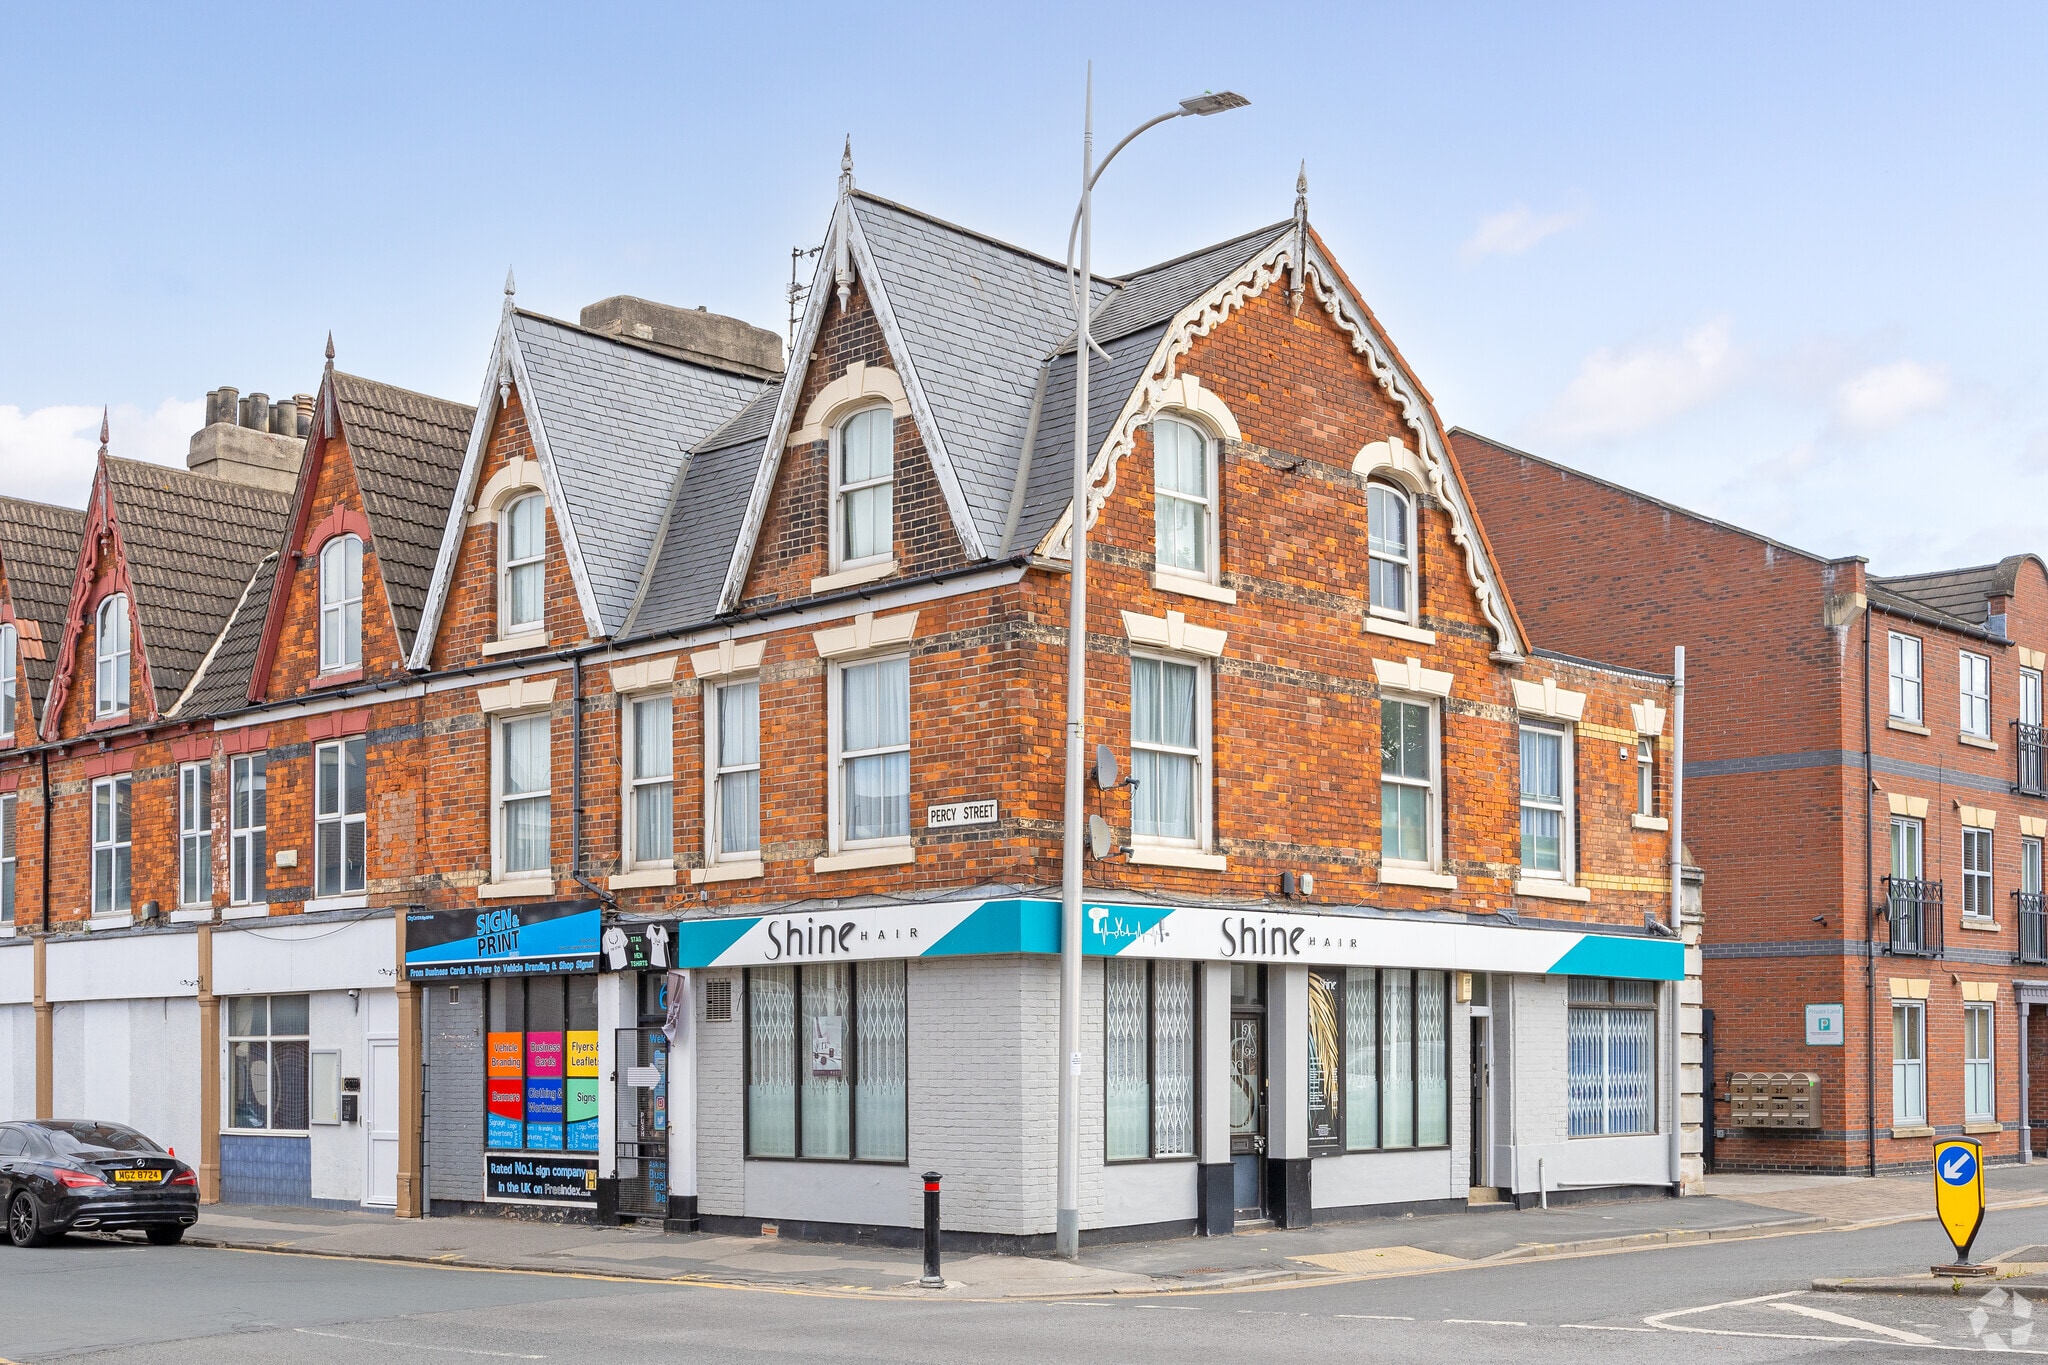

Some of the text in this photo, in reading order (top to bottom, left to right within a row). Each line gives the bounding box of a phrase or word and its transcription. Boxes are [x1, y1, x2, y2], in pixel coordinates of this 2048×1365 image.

[930, 804, 994, 823] PERCY STREET
[764, 917, 918, 960] Shine HAIR
[1220, 916, 1357, 957] Shine HAIR
[478, 930, 519, 956] PRINT
[410, 960, 594, 977] From Business Cards & Flyers to Vehicle Branding & Shop Signs!
[494, 1043, 518, 1052] Vehicle
[530, 1042, 561, 1052] Business
[572, 1041, 594, 1053] Flyers
[492, 1057, 521, 1068] Branding
[535, 1056, 557, 1066] Cards
[572, 1056, 599, 1066] Leaflet
[492, 1091, 521, 1102] Banners
[528, 1087, 556, 1101] Clothing
[577, 1092, 596, 1104] Signs
[489, 1118, 505, 1128] Signage
[137, 1170, 158, 1179] 8724
[491, 1161, 586, 1180] Rated No.1 sign company
[507, 1181, 519, 1193] the
[520, 1183, 531, 1193] UK
[533, 1186, 542, 1194] on
